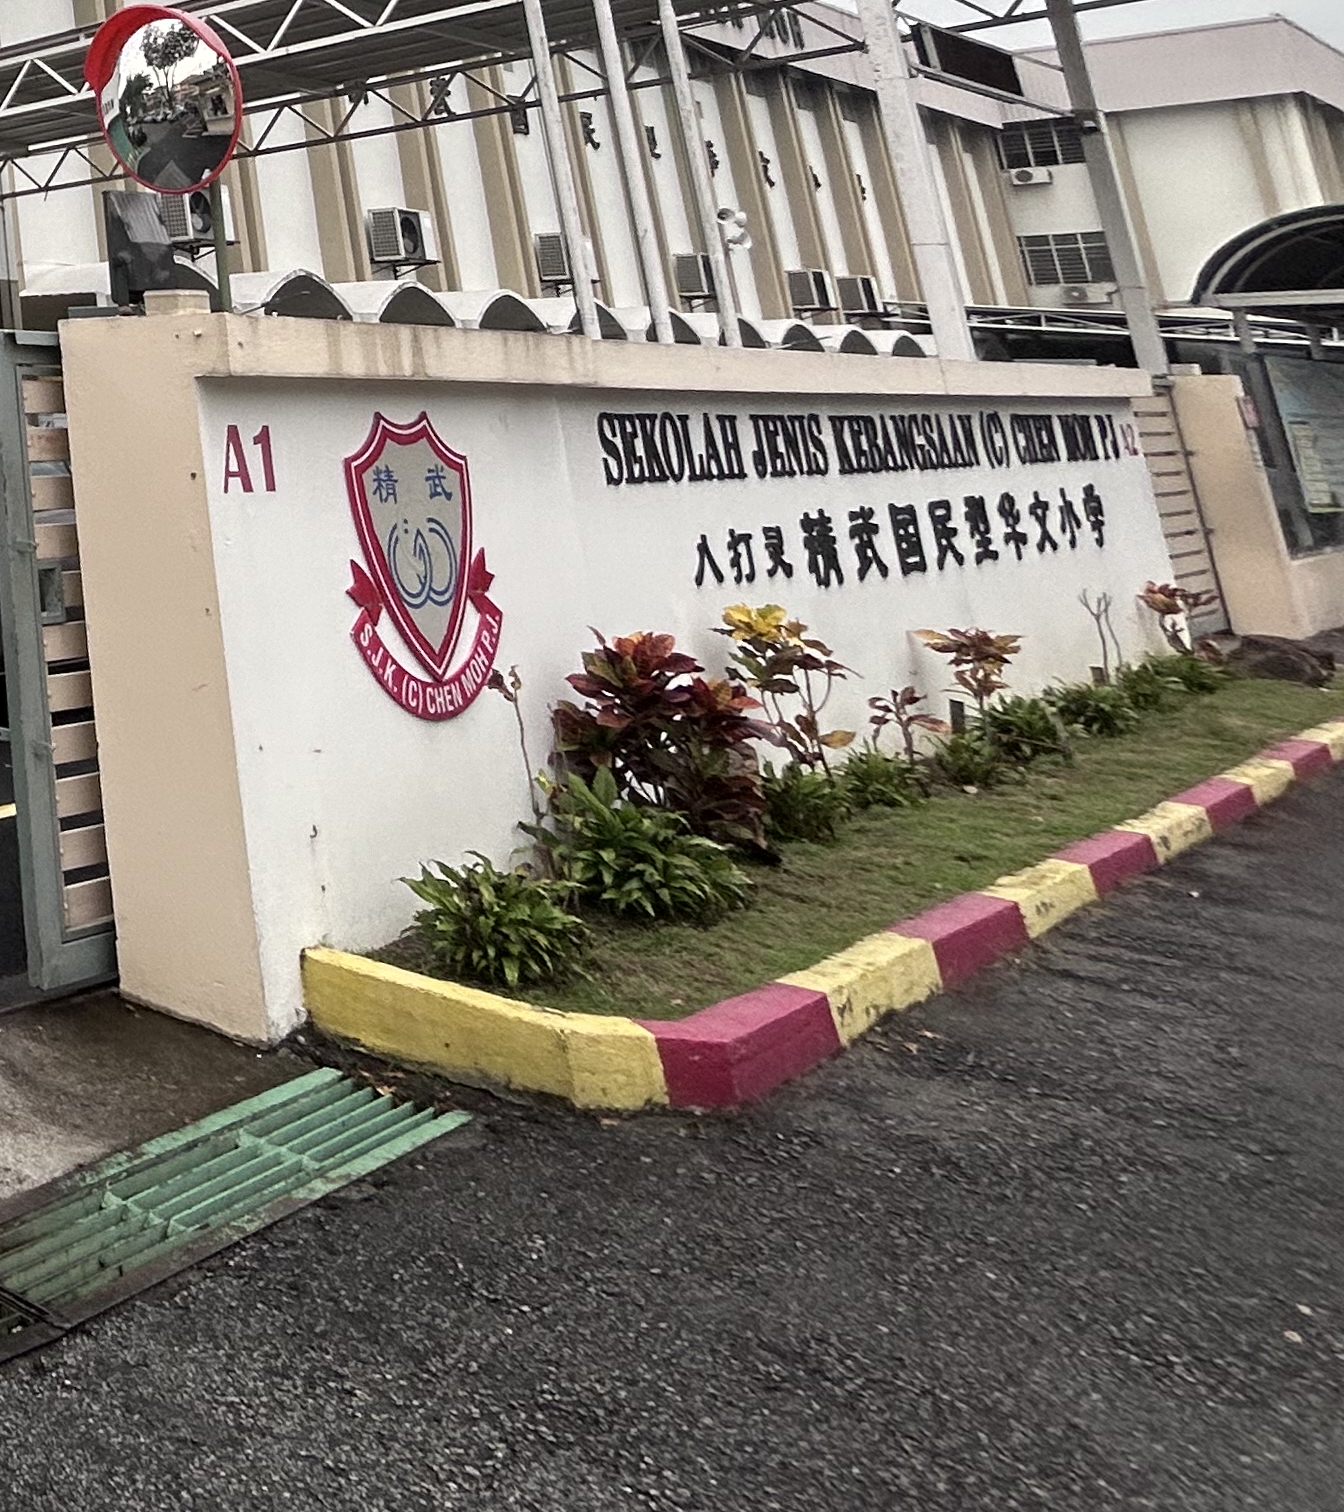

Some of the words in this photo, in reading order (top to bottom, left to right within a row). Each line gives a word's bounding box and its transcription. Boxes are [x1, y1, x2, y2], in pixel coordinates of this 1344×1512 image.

[223, 424, 277, 494] A1
[597, 411, 748, 486] SEKOLAH
[749, 413, 830, 479] JENIS
[828, 412, 981, 475] KEBANGSAAN
[979, 410, 1011, 469] (C)
[1010, 413, 1062, 465] CHEN
[401, 675, 423, 713] (C)
[426, 682, 464, 715] CHEN
[460, 645, 489, 692] MOH
